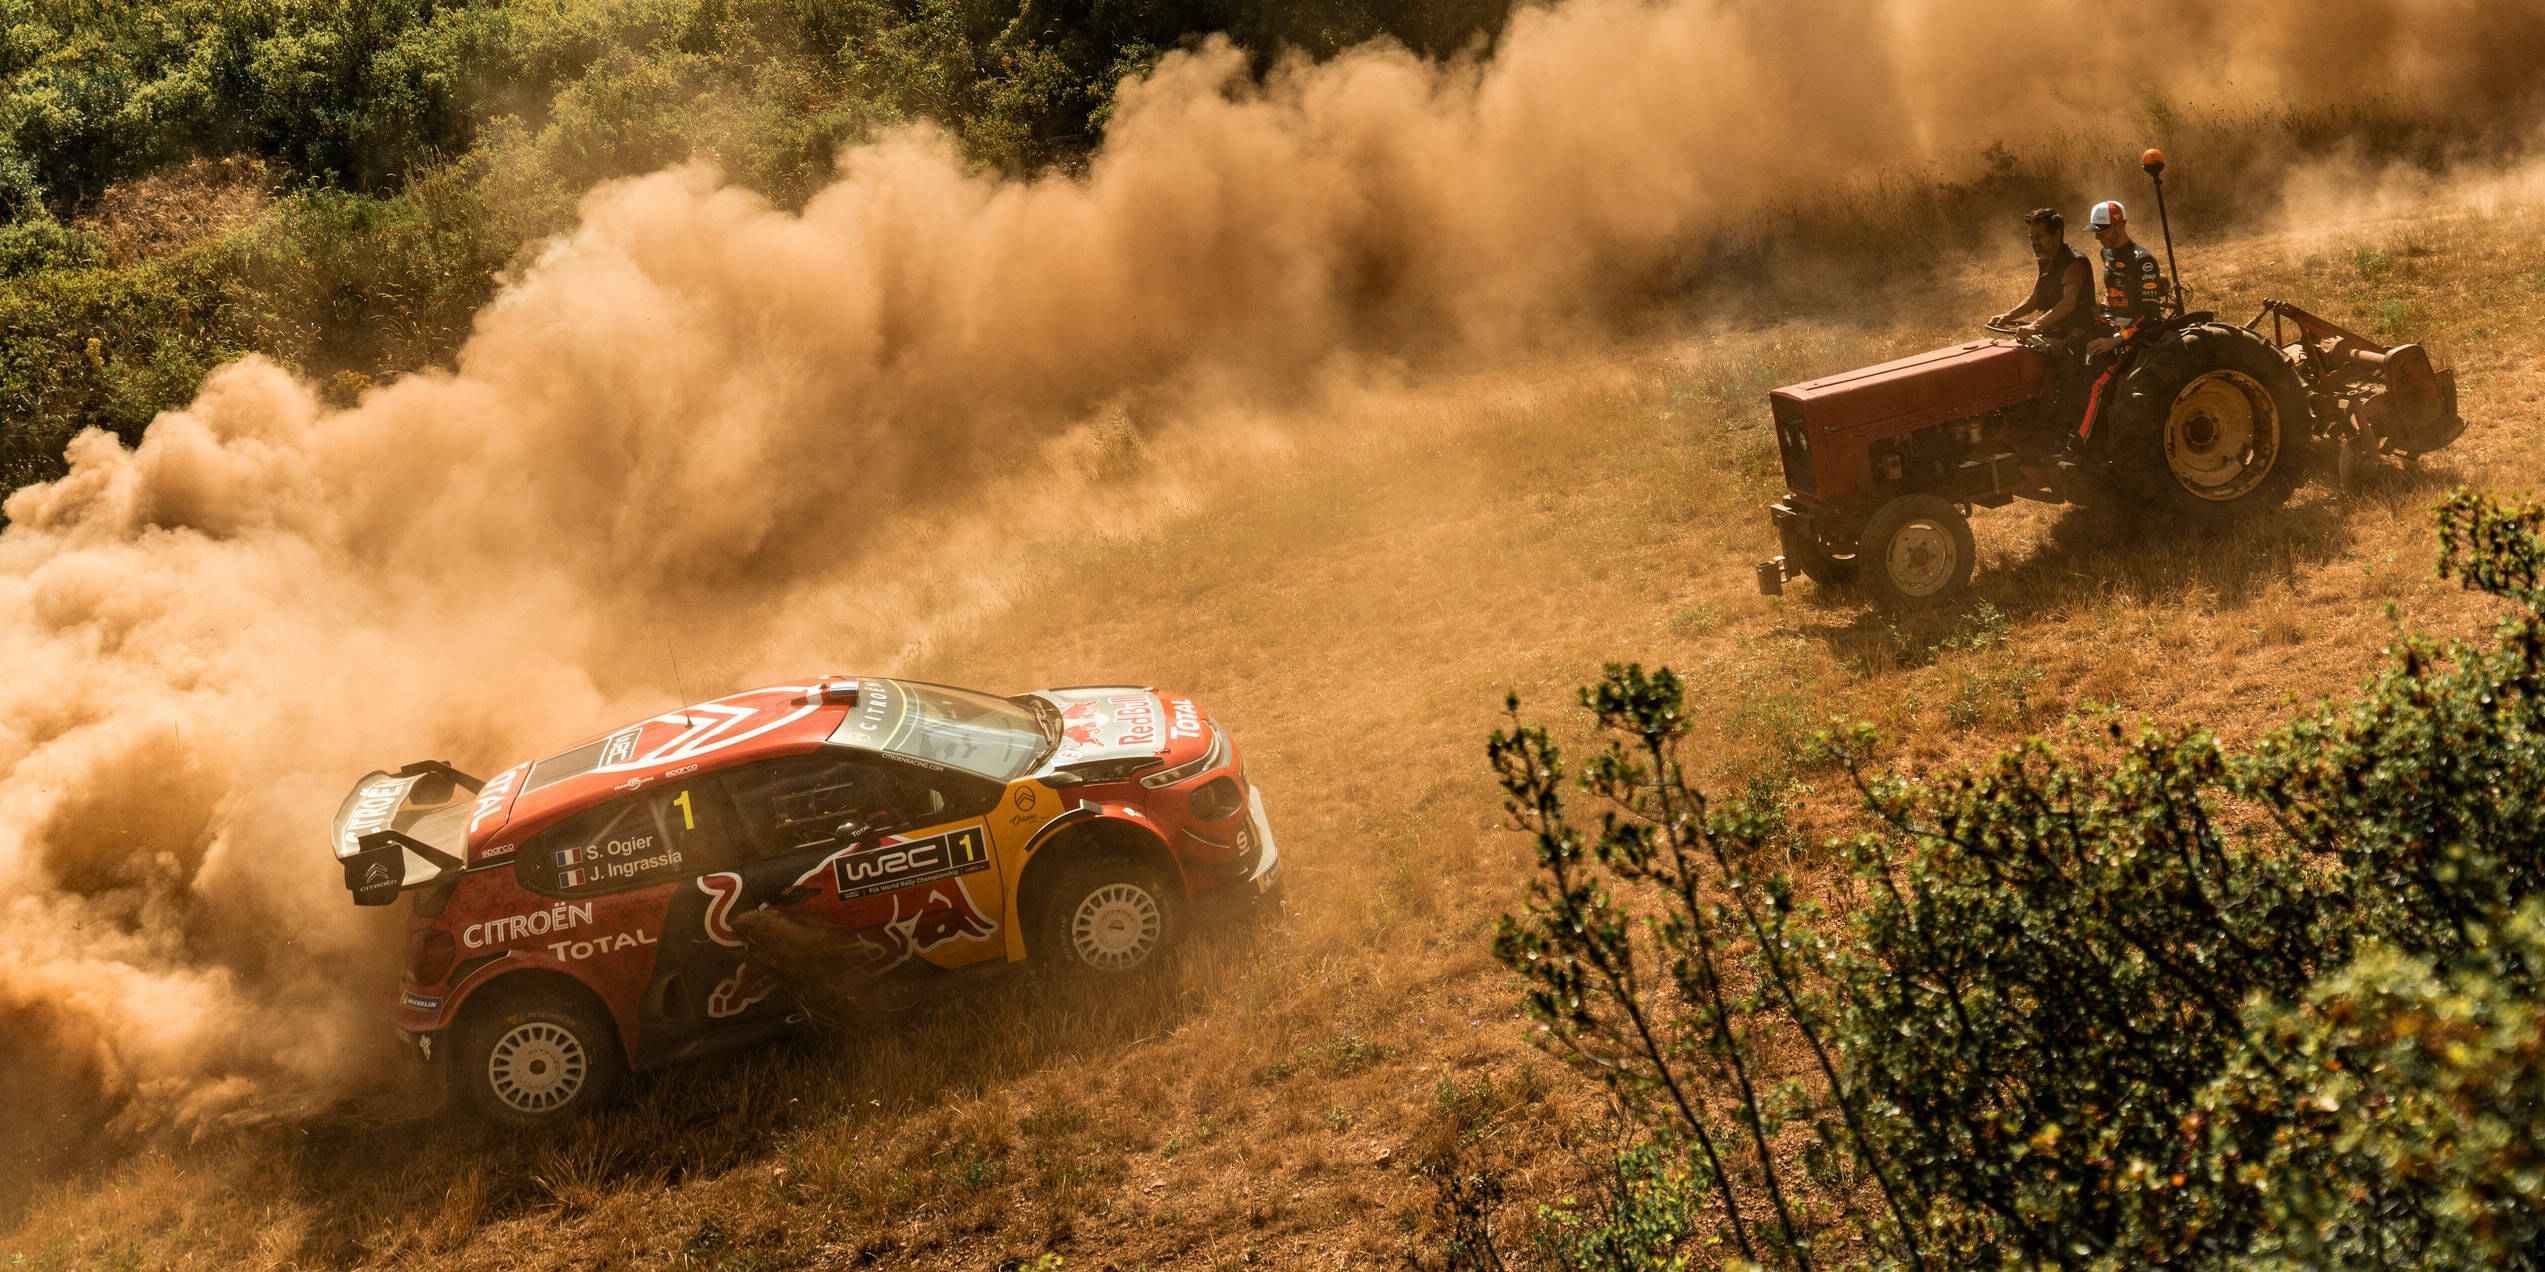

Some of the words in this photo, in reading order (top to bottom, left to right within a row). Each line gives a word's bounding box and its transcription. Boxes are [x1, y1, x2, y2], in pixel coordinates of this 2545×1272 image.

[1170, 699, 1200, 739] TOTAL
[673, 790, 694, 830] 1
[586, 844, 602, 860] S.
[607, 834, 653, 857] Ogier
[846, 844, 938, 881] WRC
[959, 834, 974, 861] 1
[590, 865, 605, 881] J.
[608, 850, 683, 877] Ingrassia
[868, 886, 880, 894] FIA
[880, 881, 900, 892] World
[900, 878, 915, 889] Rally
[916, 869, 959, 884] Championship
[463, 901, 592, 948] CITROËN
[548, 928, 658, 962] TOTAL
